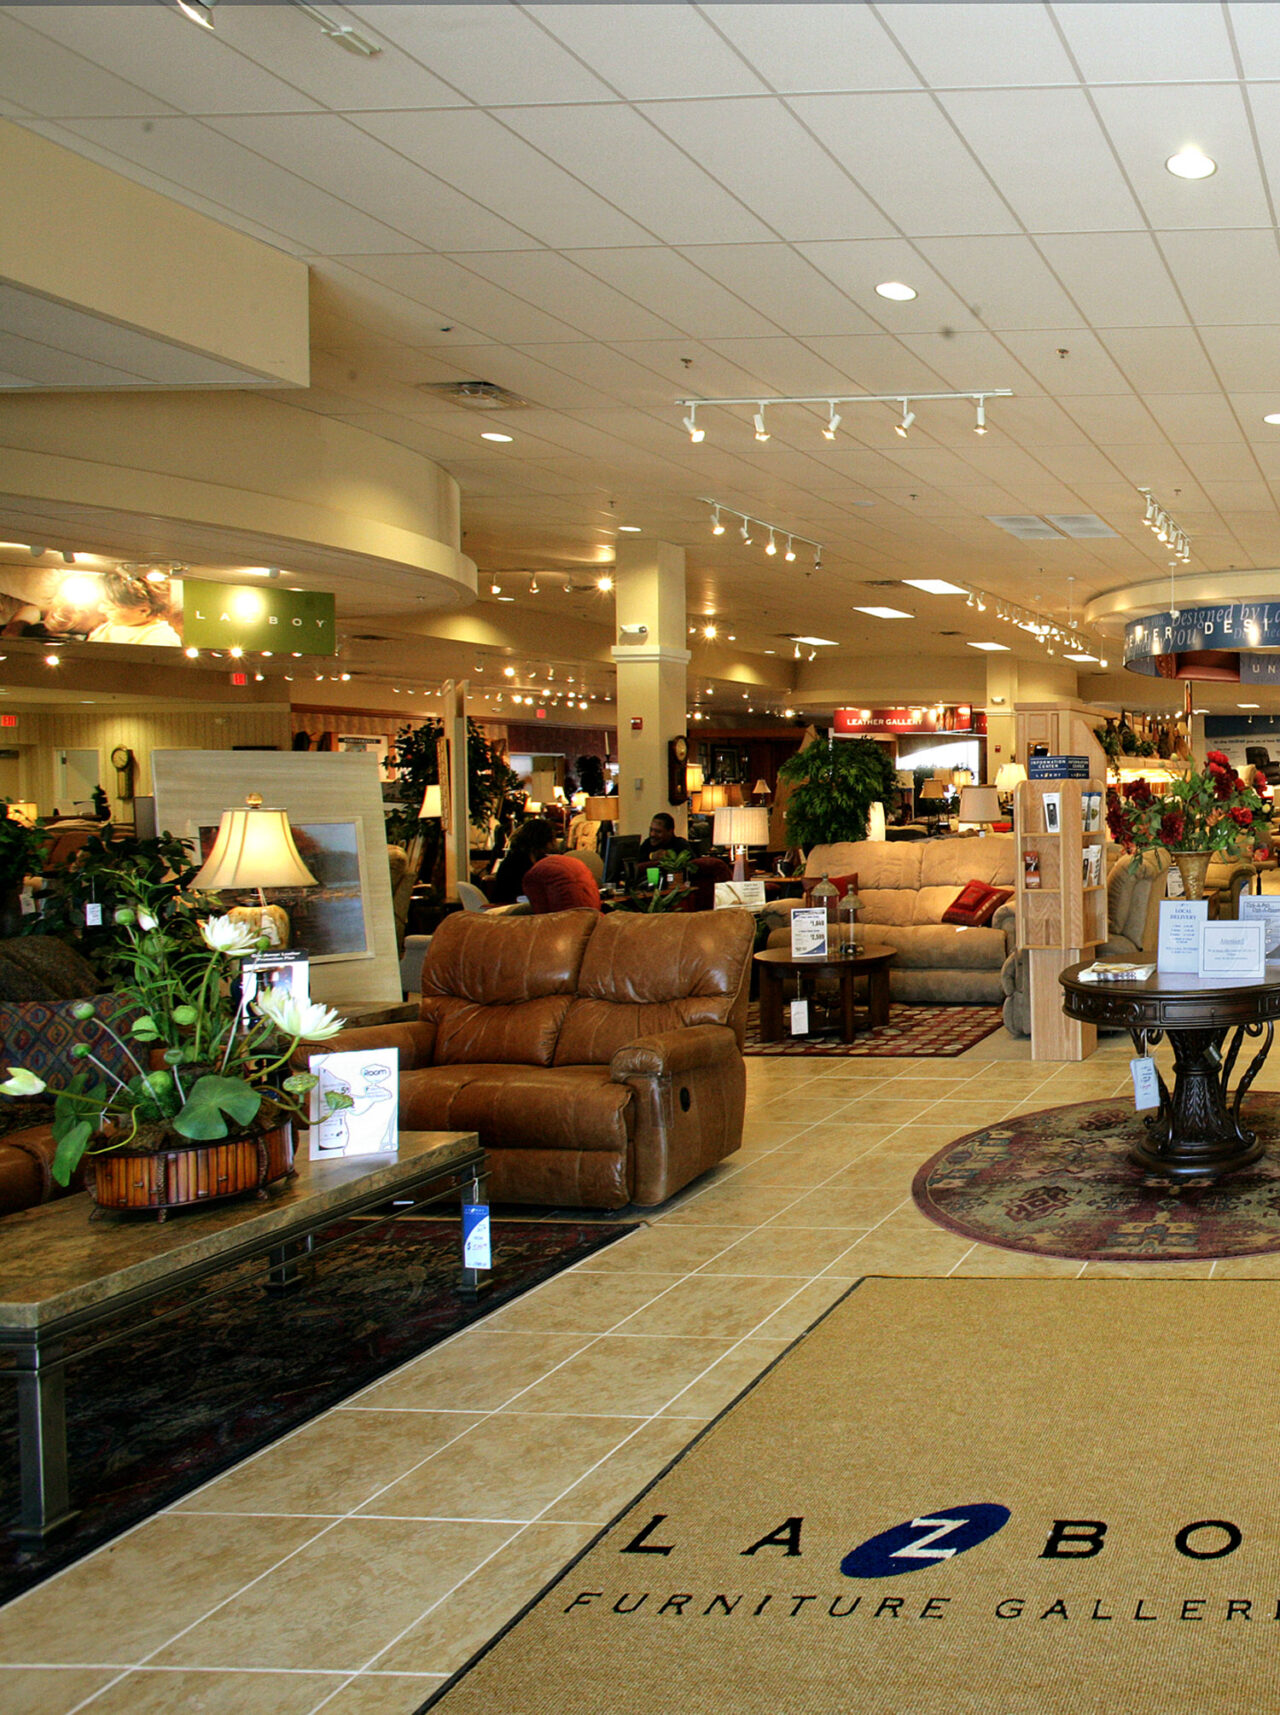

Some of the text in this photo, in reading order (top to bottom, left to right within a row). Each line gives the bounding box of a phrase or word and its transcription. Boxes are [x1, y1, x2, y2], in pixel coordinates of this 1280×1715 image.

[847, 718, 922, 726] LEATHER GALLERY
[563, 1592, 952, 1620] FURNITURE
